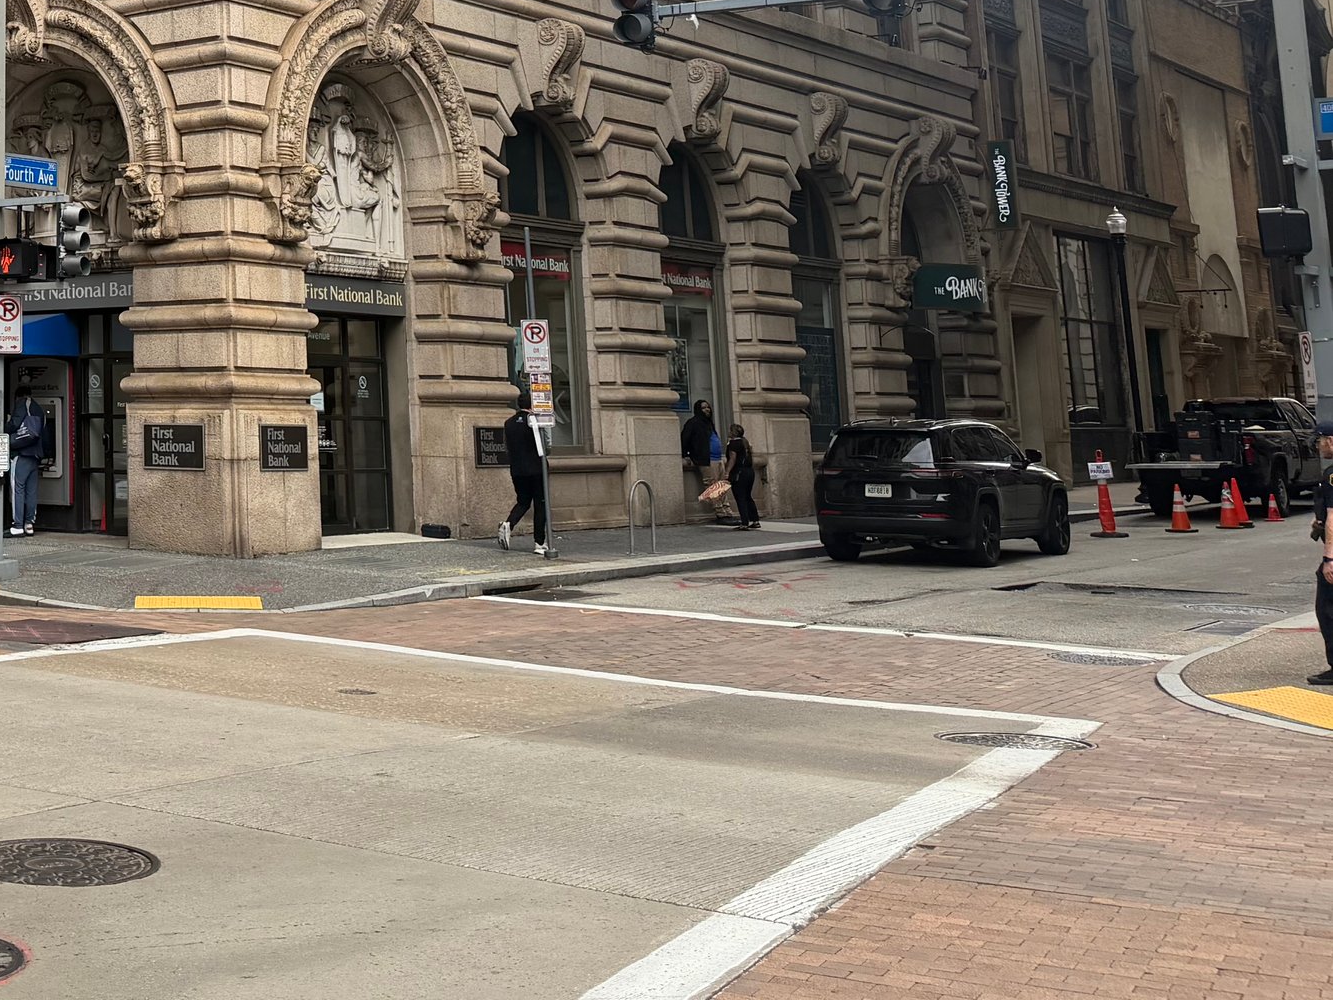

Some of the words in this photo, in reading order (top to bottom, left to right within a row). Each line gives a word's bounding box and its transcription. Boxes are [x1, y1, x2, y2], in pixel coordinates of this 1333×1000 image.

[4, 165, 35, 183] Fourth
[37, 169, 54, 185] Ave
[993, 155, 1009, 186] BANK
[995, 183, 1011, 223] TOWER
[515, 254, 549, 271] Naonal
[549, 258, 570, 273] Bank
[667, 272, 695, 288] National
[695, 276, 713, 290] Bank
[304, 283, 328, 300] First
[330, 285, 374, 304] National
[376, 290, 403, 307] Bank
[934, 286, 945, 295] THE
[945, 276, 981, 301] BANK
[151, 427, 174, 439] First
[267, 428, 285, 440] First
[480, 429, 494, 440] First
[151, 440, 196, 453] National
[267, 441, 302, 454] National
[481, 441, 507, 452] Nationa
[152, 453, 179, 466] Bank
[268, 455, 290, 467] Bank
[481, 453, 499, 464] Bank
